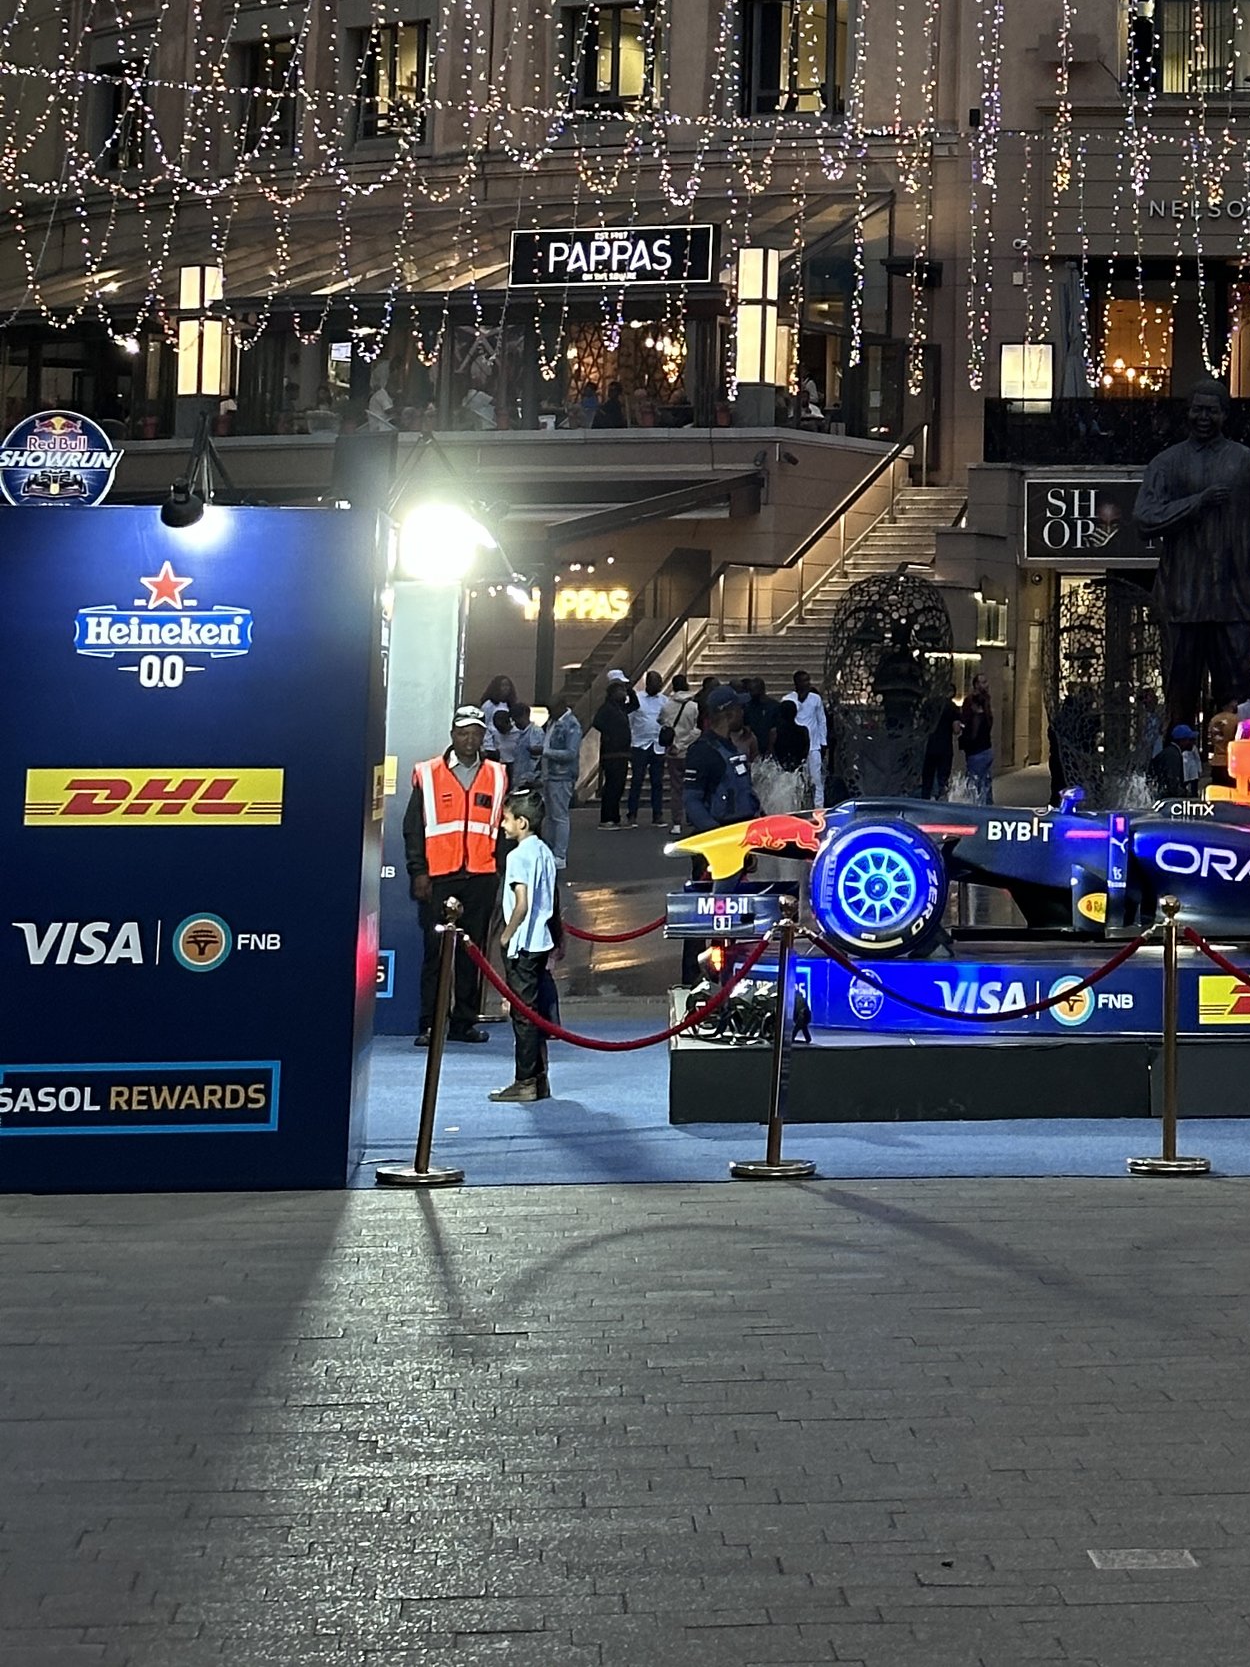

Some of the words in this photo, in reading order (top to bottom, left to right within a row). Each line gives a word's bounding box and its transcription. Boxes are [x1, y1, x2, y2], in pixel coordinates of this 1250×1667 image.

[549, 239, 672, 273] PAPPAS
[28, 436, 57, 451] Red
[58, 436, 88, 451] Bull
[0, 450, 117, 469] SHOWRUN
[84, 615, 242, 645] Heineken
[139, 654, 184, 688] 0.0
[58, 778, 249, 816] DHL
[987, 817, 1053, 842] BYBIT
[697, 897, 748, 915] Mobil
[11, 921, 144, 965] VISA
[237, 934, 281, 951] FNB
[934, 981, 1028, 1018] VISA
[1098, 994, 1134, 1009] FNB
[0, 1087, 101, 1113] SASOL
[109, 1084, 266, 1111] REWARDS
